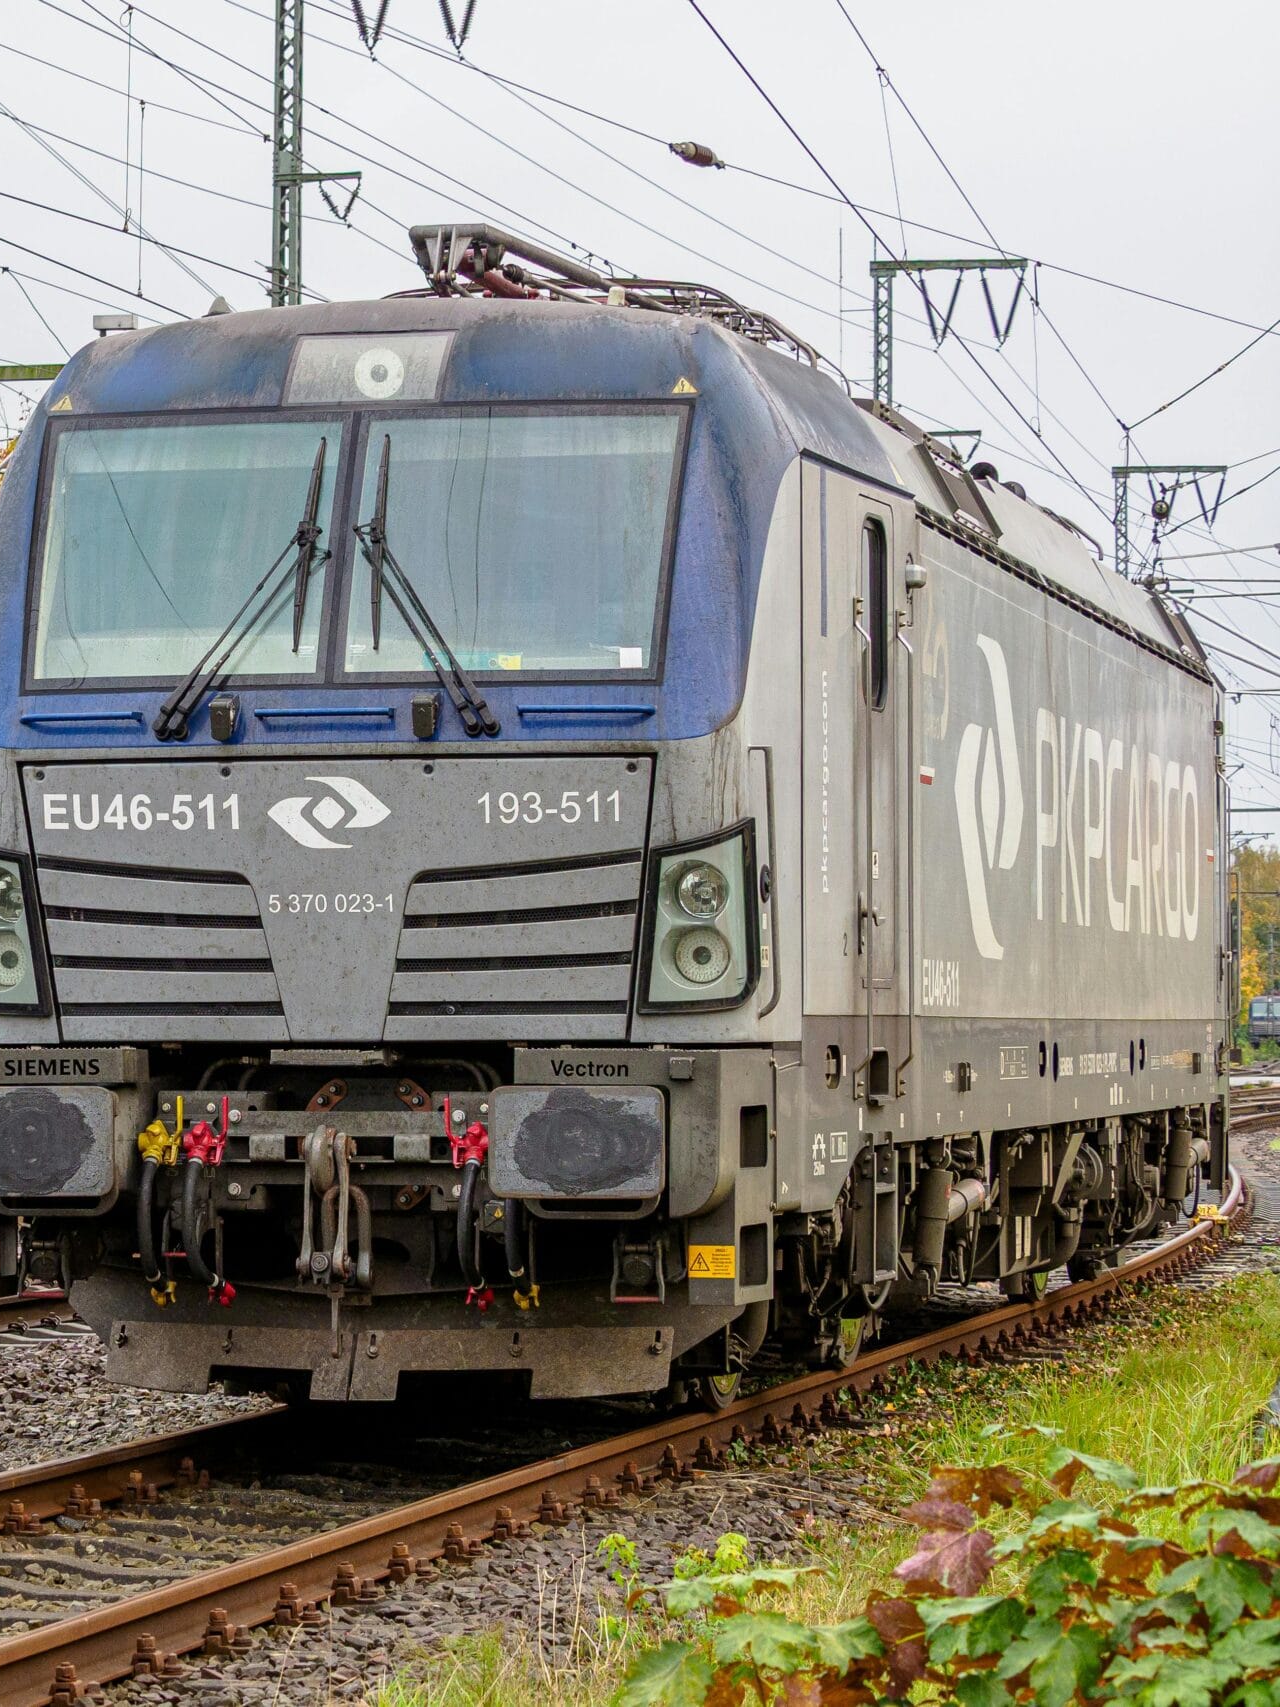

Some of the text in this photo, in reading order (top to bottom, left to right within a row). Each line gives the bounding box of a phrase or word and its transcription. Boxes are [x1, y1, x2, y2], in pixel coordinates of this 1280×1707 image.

[821, 670, 830, 893] pkpcargo.com
[43, 793, 240, 831] EU46-511
[477, 790, 621, 824] 193-511
[268, 893, 394, 913] 5 370 023-1
[922, 958, 960, 1007] EU46-511
[4, 1059, 100, 1076] SIEMENS
[551, 1060, 629, 1077] Vectron
